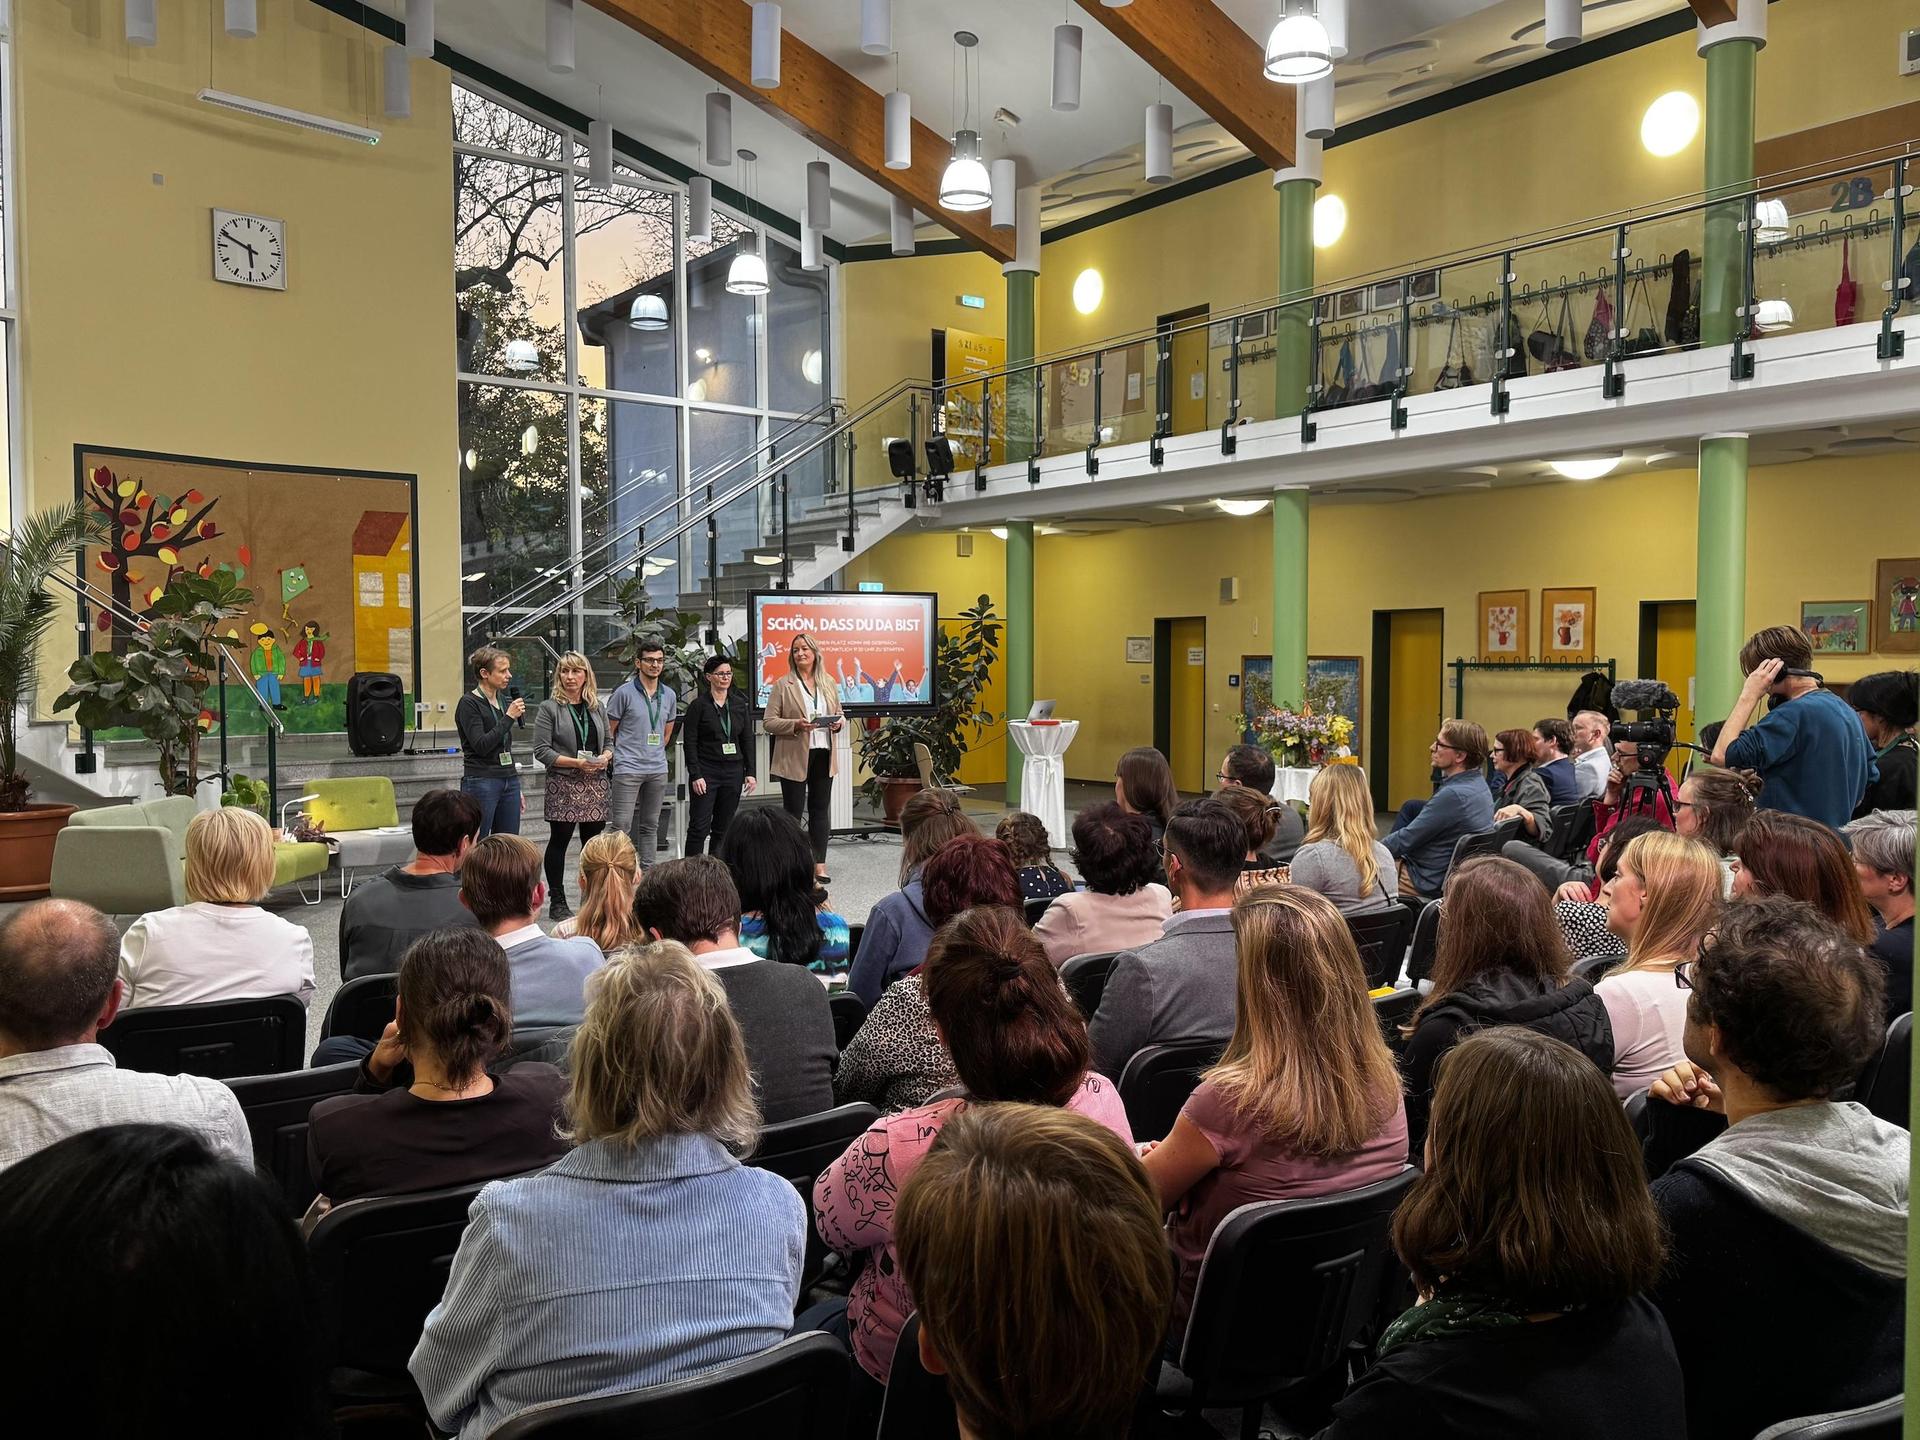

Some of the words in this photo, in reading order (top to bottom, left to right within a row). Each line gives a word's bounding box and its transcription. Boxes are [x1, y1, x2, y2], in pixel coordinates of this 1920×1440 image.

[1831, 177, 1873, 212] 2B
[767, 613, 818, 633] SCHÖN,
[820, 618, 854, 632] DASS
[856, 618, 873, 632] DU
[875, 618, 893, 632] DA
[895, 618, 920, 632] BIST
